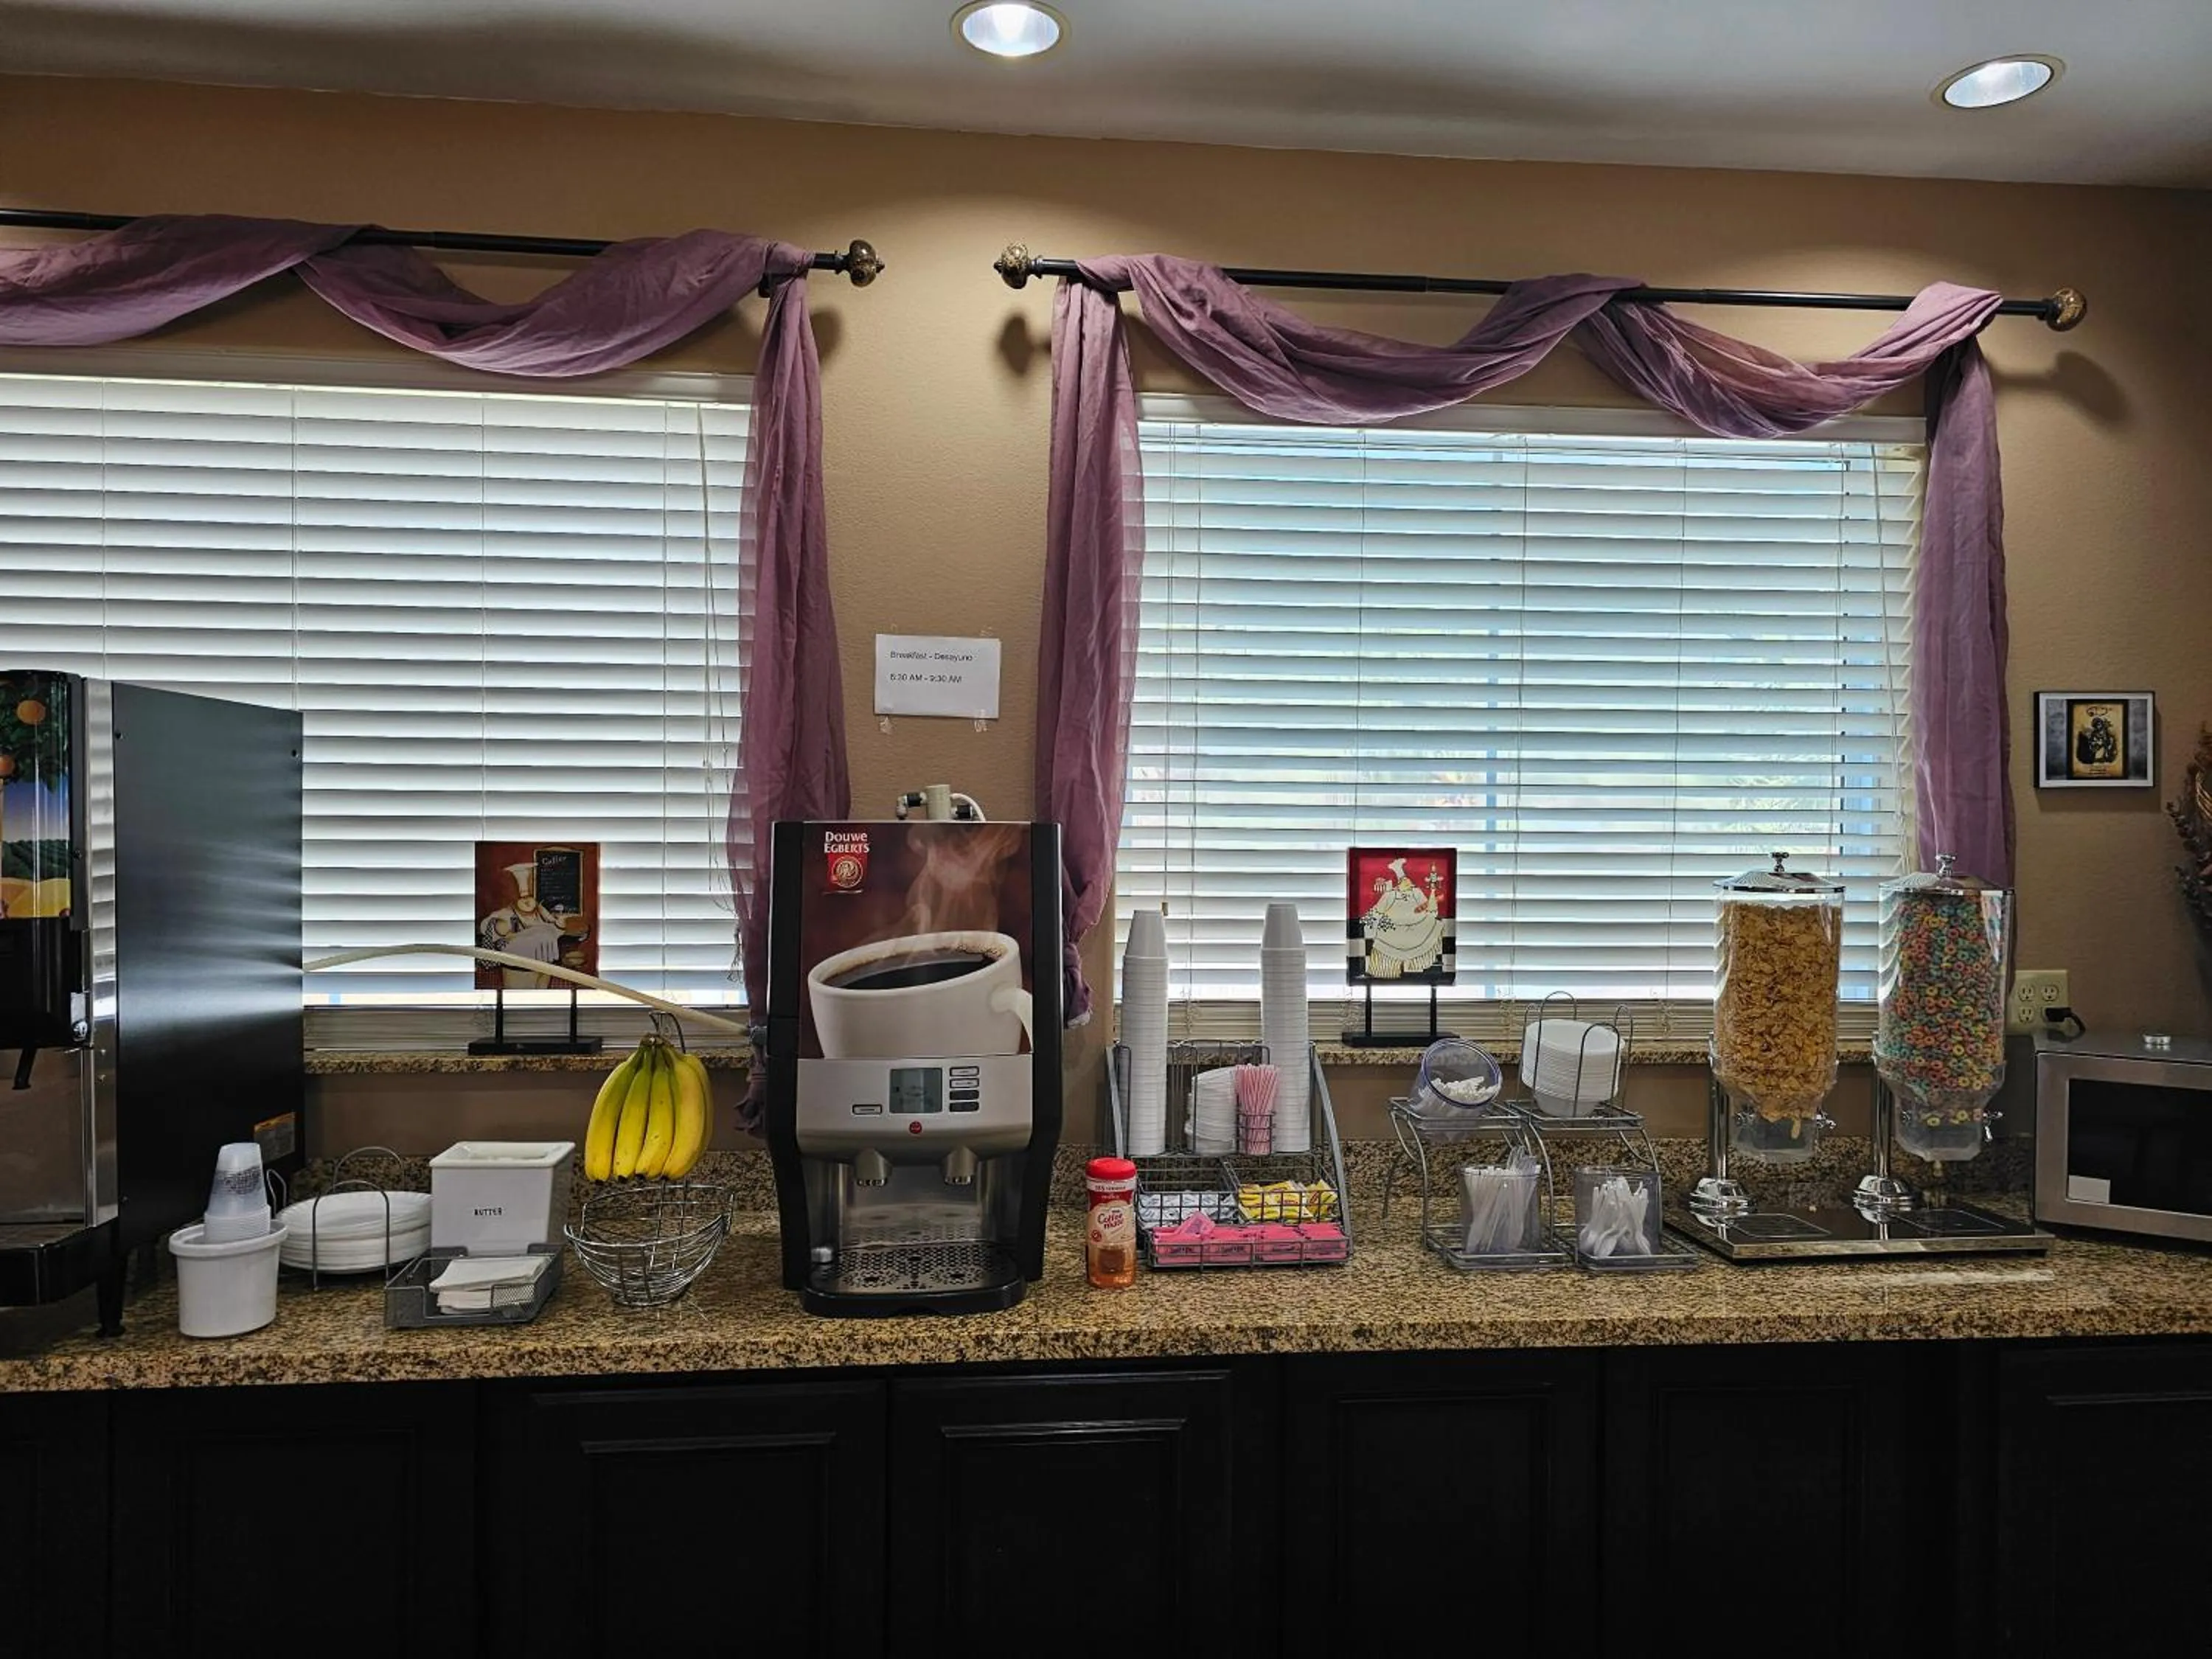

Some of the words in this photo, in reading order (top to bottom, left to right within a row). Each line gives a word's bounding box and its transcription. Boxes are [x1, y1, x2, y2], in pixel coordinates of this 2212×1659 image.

[890, 651, 927, 659] Breakfast
[934, 653, 973, 662] Desayuno
[825, 831, 868, 842] Douwe
[824, 843, 870, 853] EGBERTS
[474, 1206, 503, 1216] BUTTER
